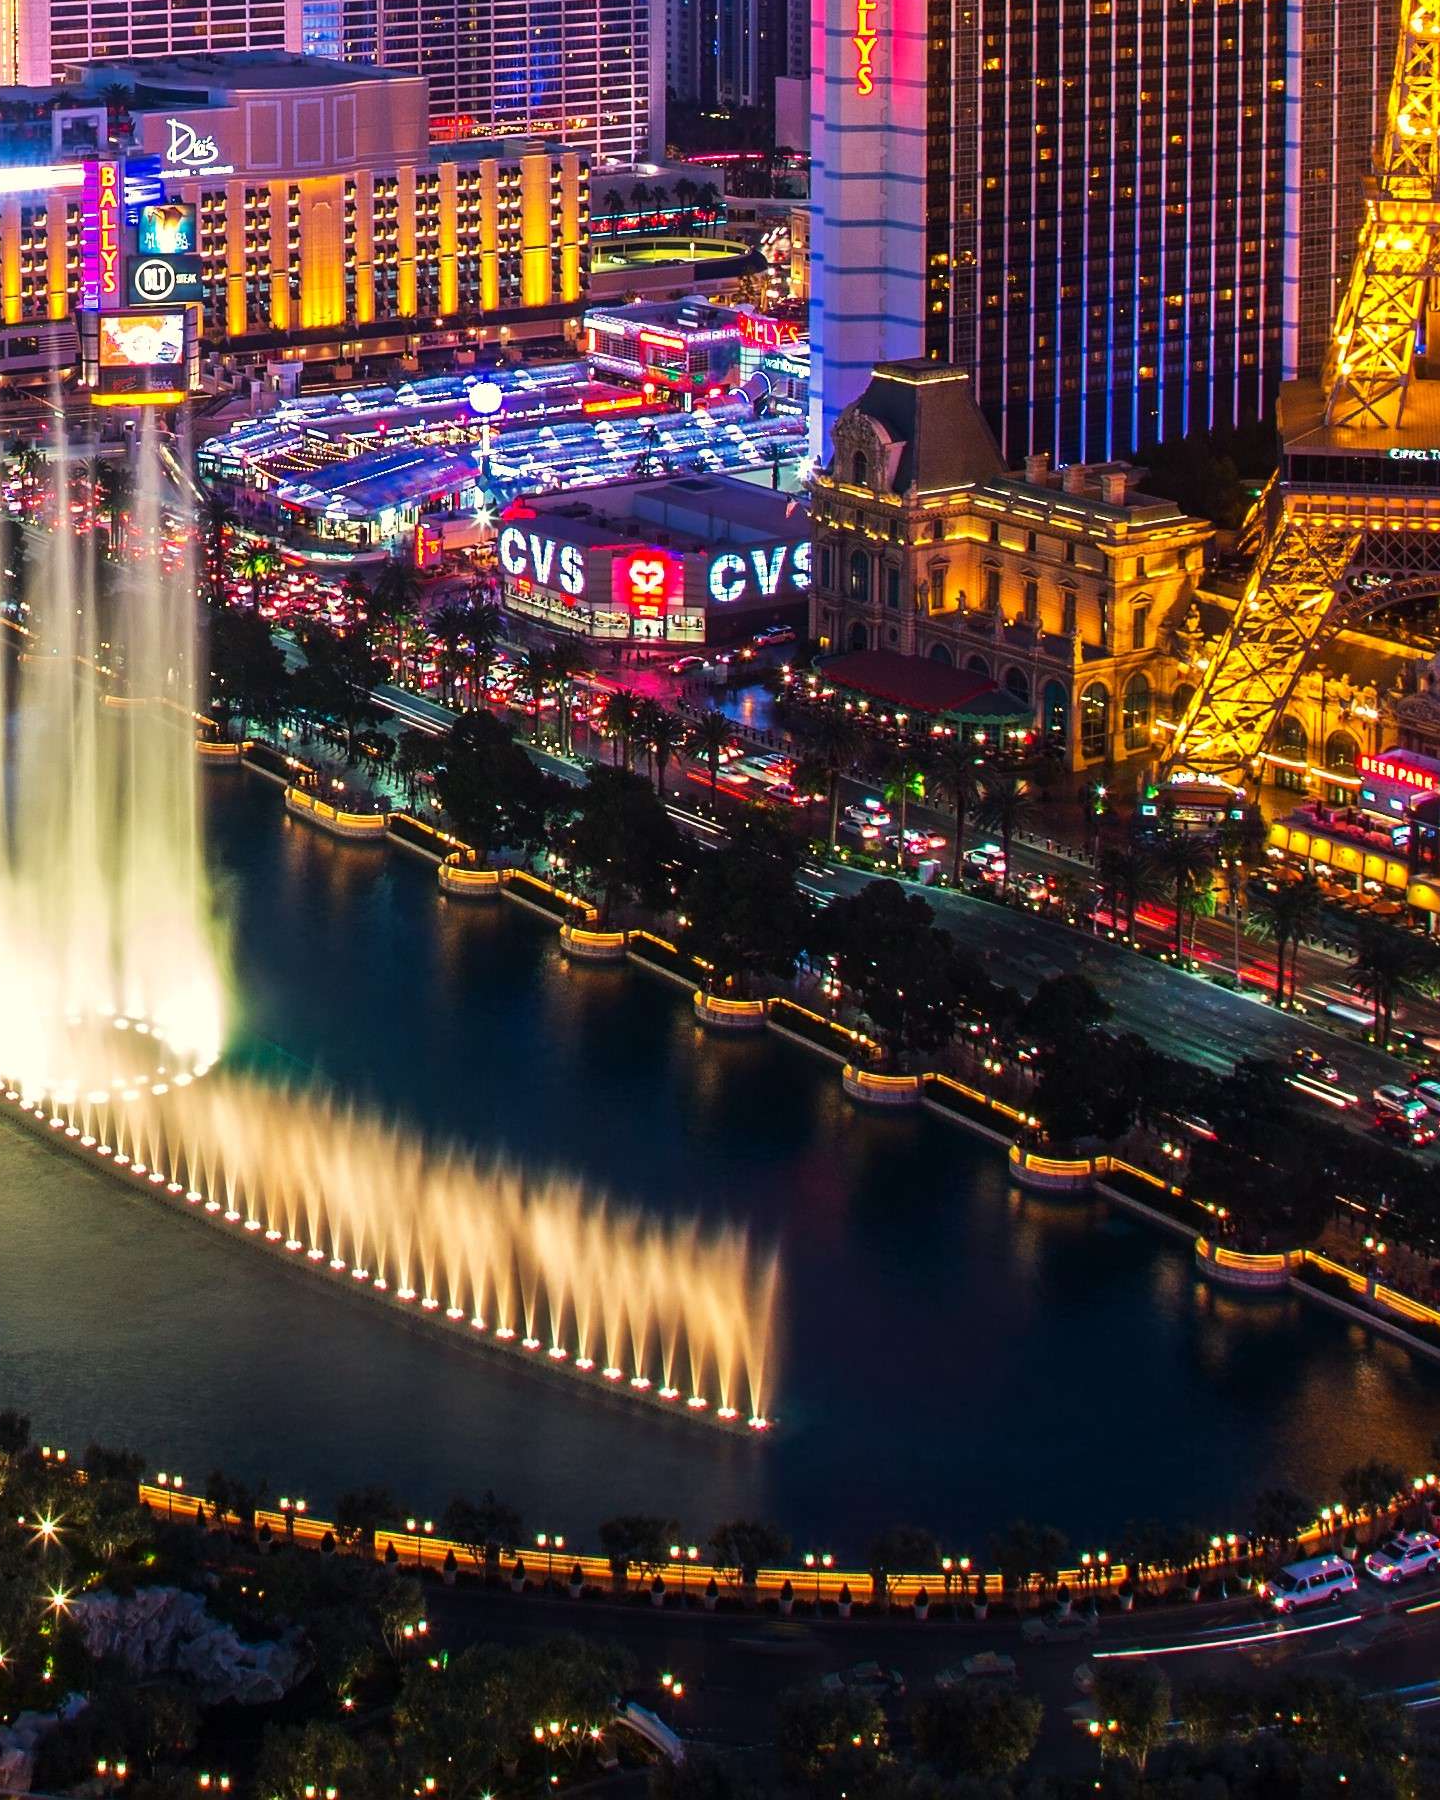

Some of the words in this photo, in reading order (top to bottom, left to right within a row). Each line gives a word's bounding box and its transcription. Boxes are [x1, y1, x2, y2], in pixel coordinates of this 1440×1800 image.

[100, 166, 118, 293] BALLYS
[143, 267, 167, 292] BLT
[740, 312, 800, 346] ALLY'S
[1390, 447, 1429, 461] EIFFEL
[499, 526, 585, 594] CVS
[1361, 756, 1395, 779] BEER
[1398, 767, 1434, 791] PARK
